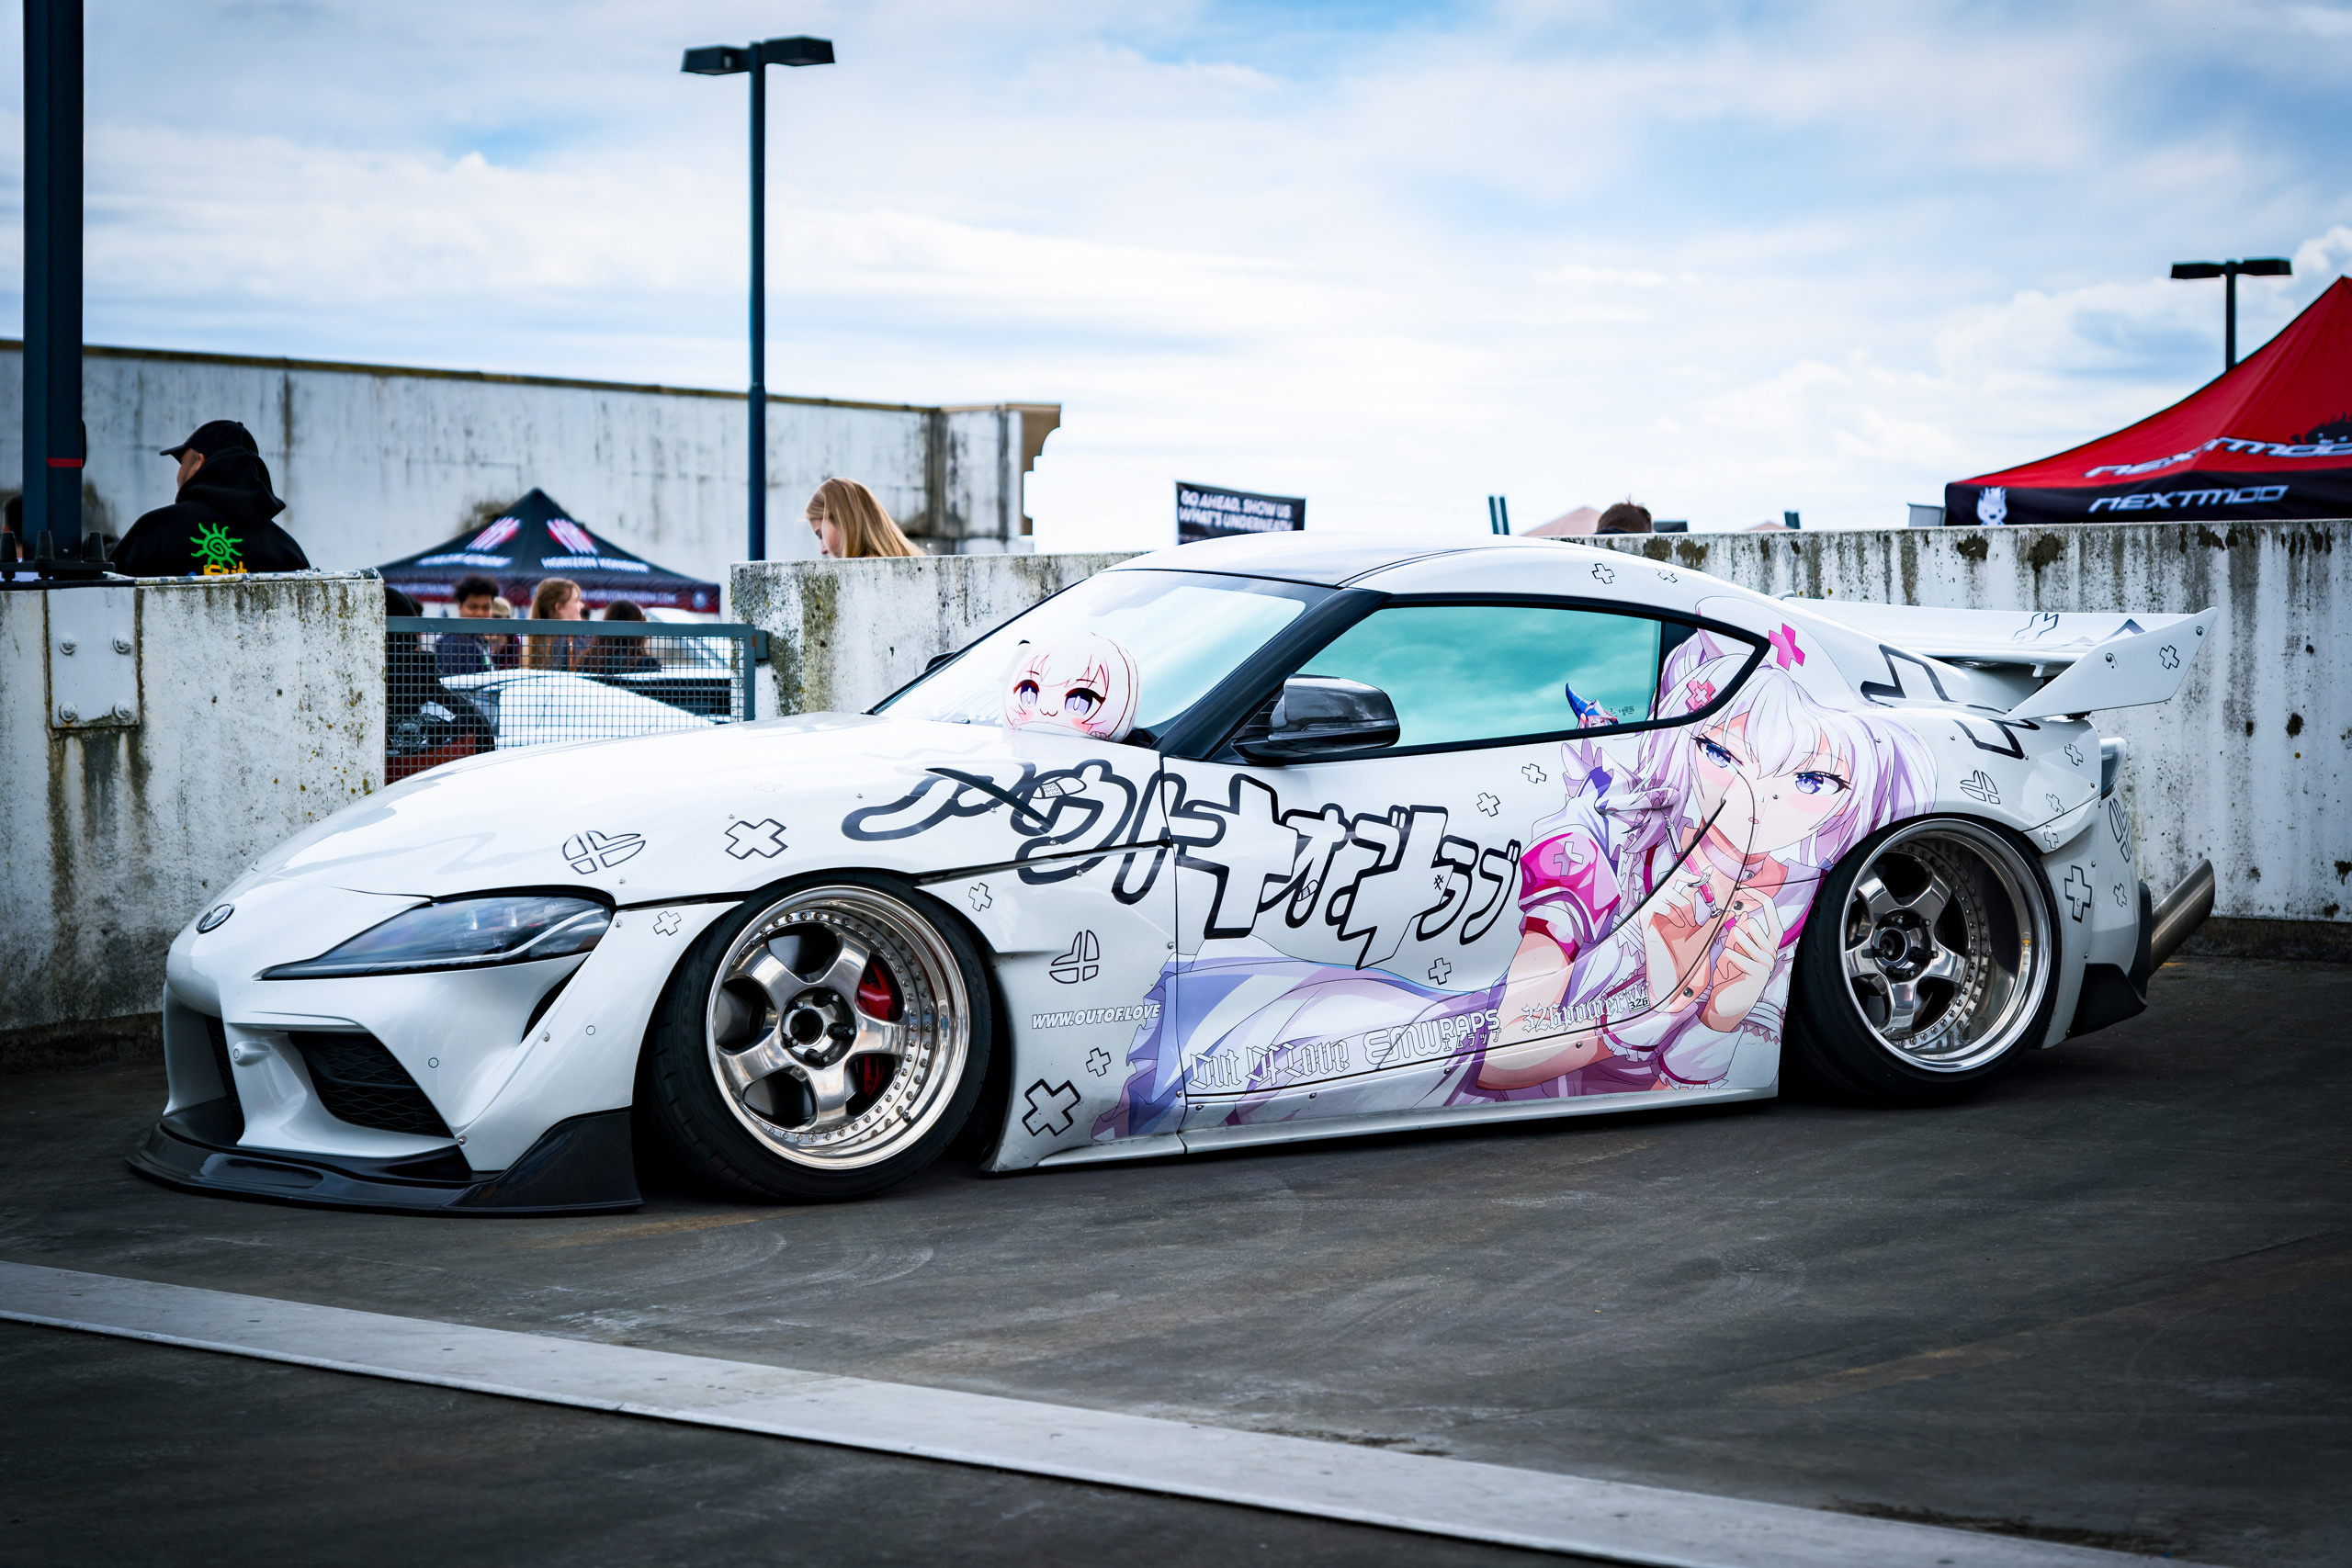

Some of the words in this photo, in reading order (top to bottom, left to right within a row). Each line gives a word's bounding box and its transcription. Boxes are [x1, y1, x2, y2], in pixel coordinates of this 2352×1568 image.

[1181, 490, 1199, 506] GO
[1242, 499, 1276, 517] SHOW
[1277, 503, 1293, 519] US
[1179, 506, 1222, 526] WHAT'S
[1223, 513, 1294, 531] UNDERNEATH
[1629, 996, 1649, 1010] 326
[1032, 1004, 1161, 1029] WWW.OUTOF.LOVE
